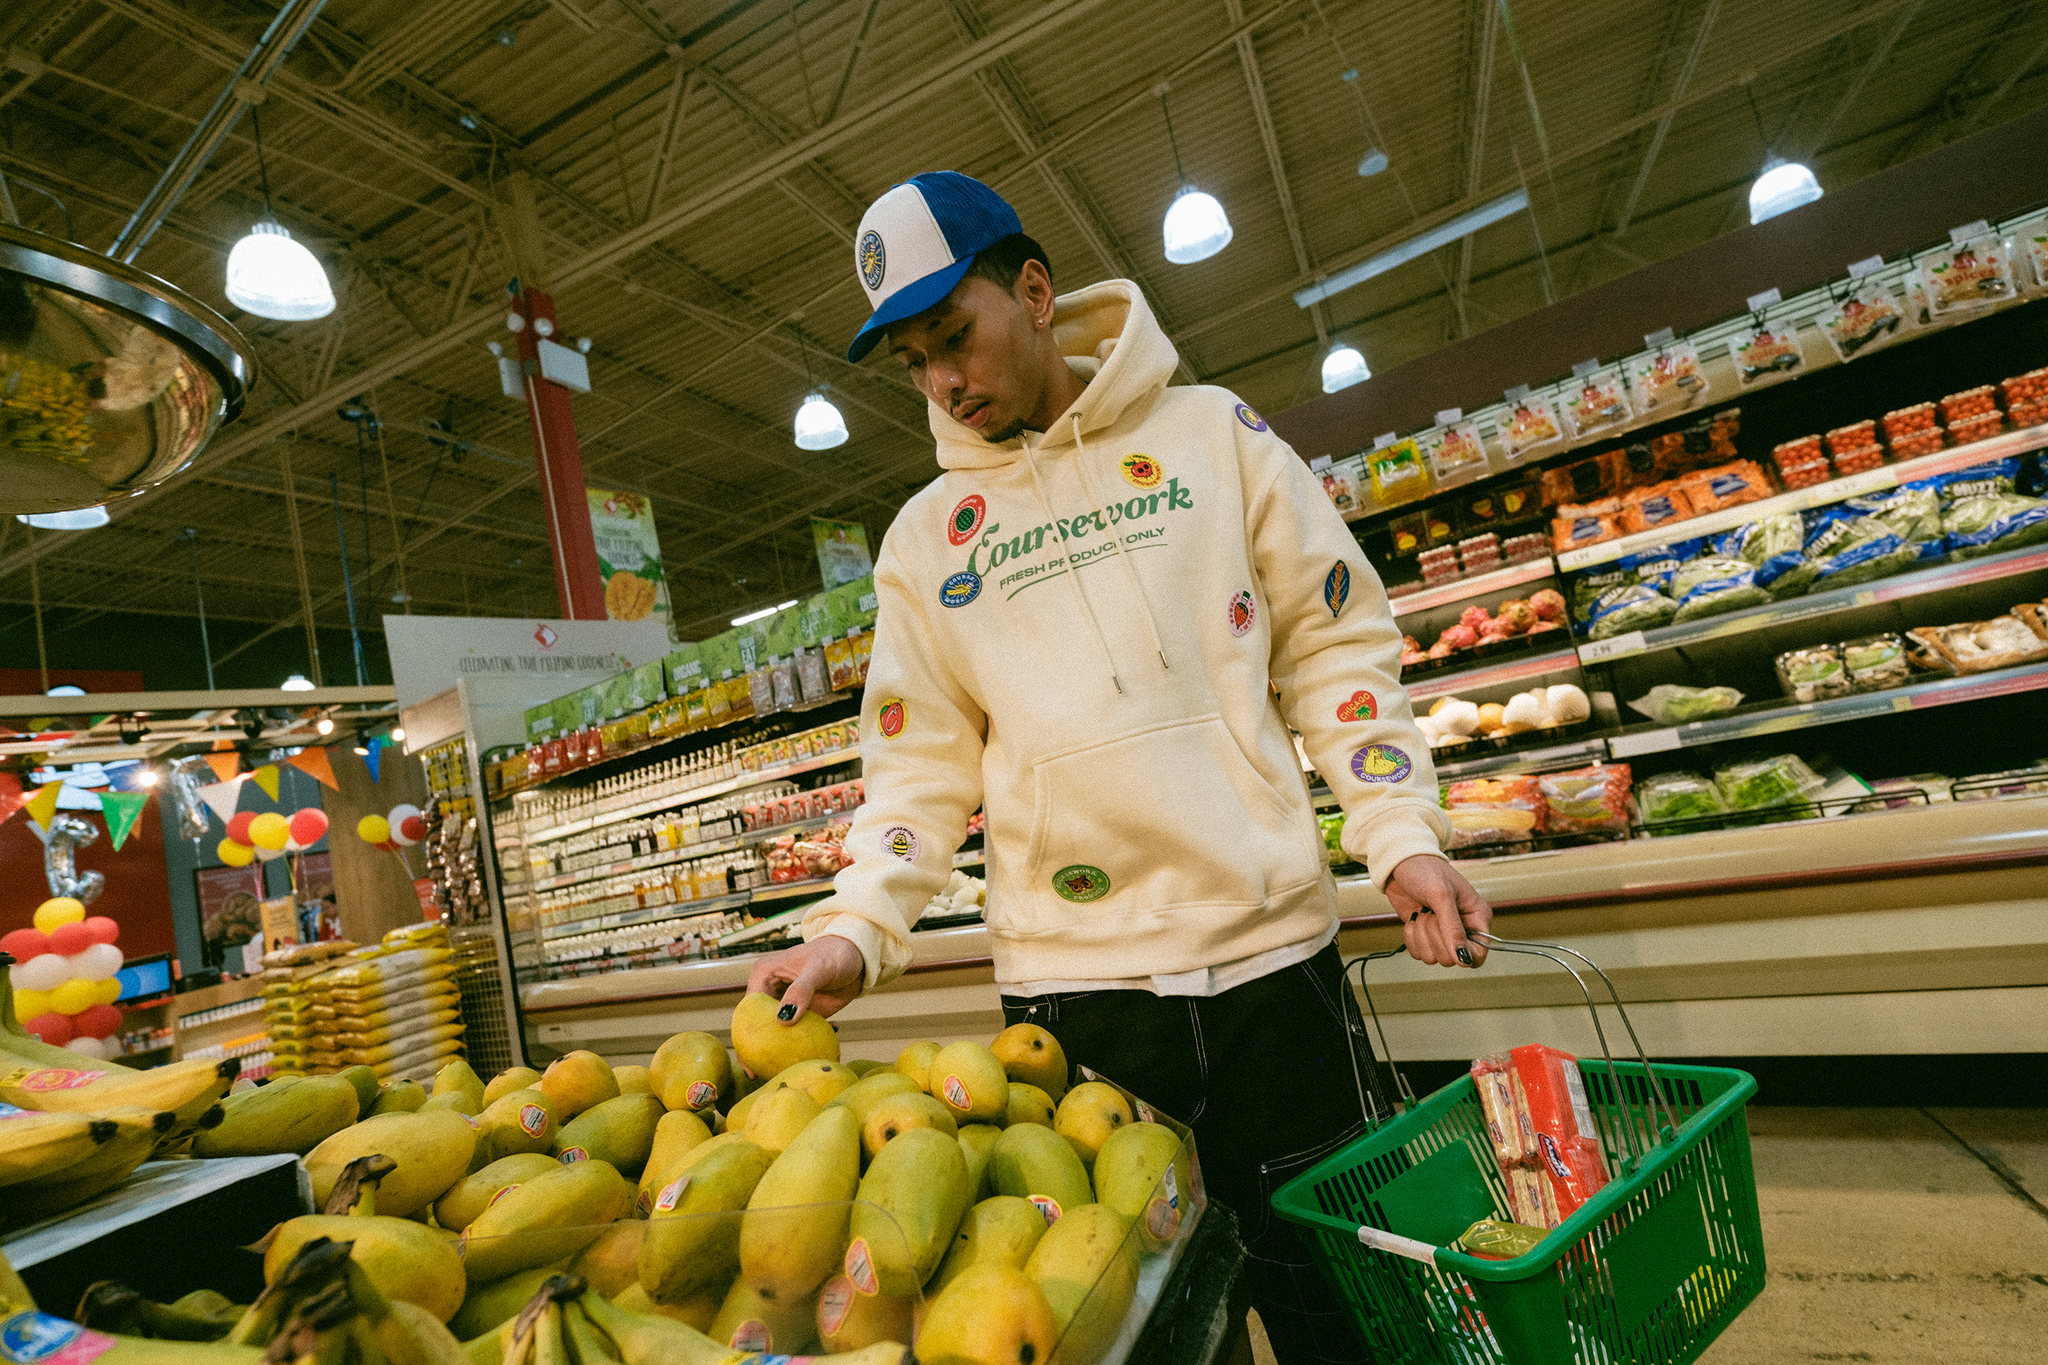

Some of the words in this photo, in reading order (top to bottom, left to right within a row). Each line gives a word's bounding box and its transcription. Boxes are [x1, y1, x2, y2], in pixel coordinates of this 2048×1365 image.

[967, 477, 1194, 578] Coursework
[999, 563, 1046, 590] FRESH
[1125, 526, 1166, 544] ONLY
[1339, 692, 1371, 720] CHICAGO
[1359, 766, 1410, 783] COURSEWORK
